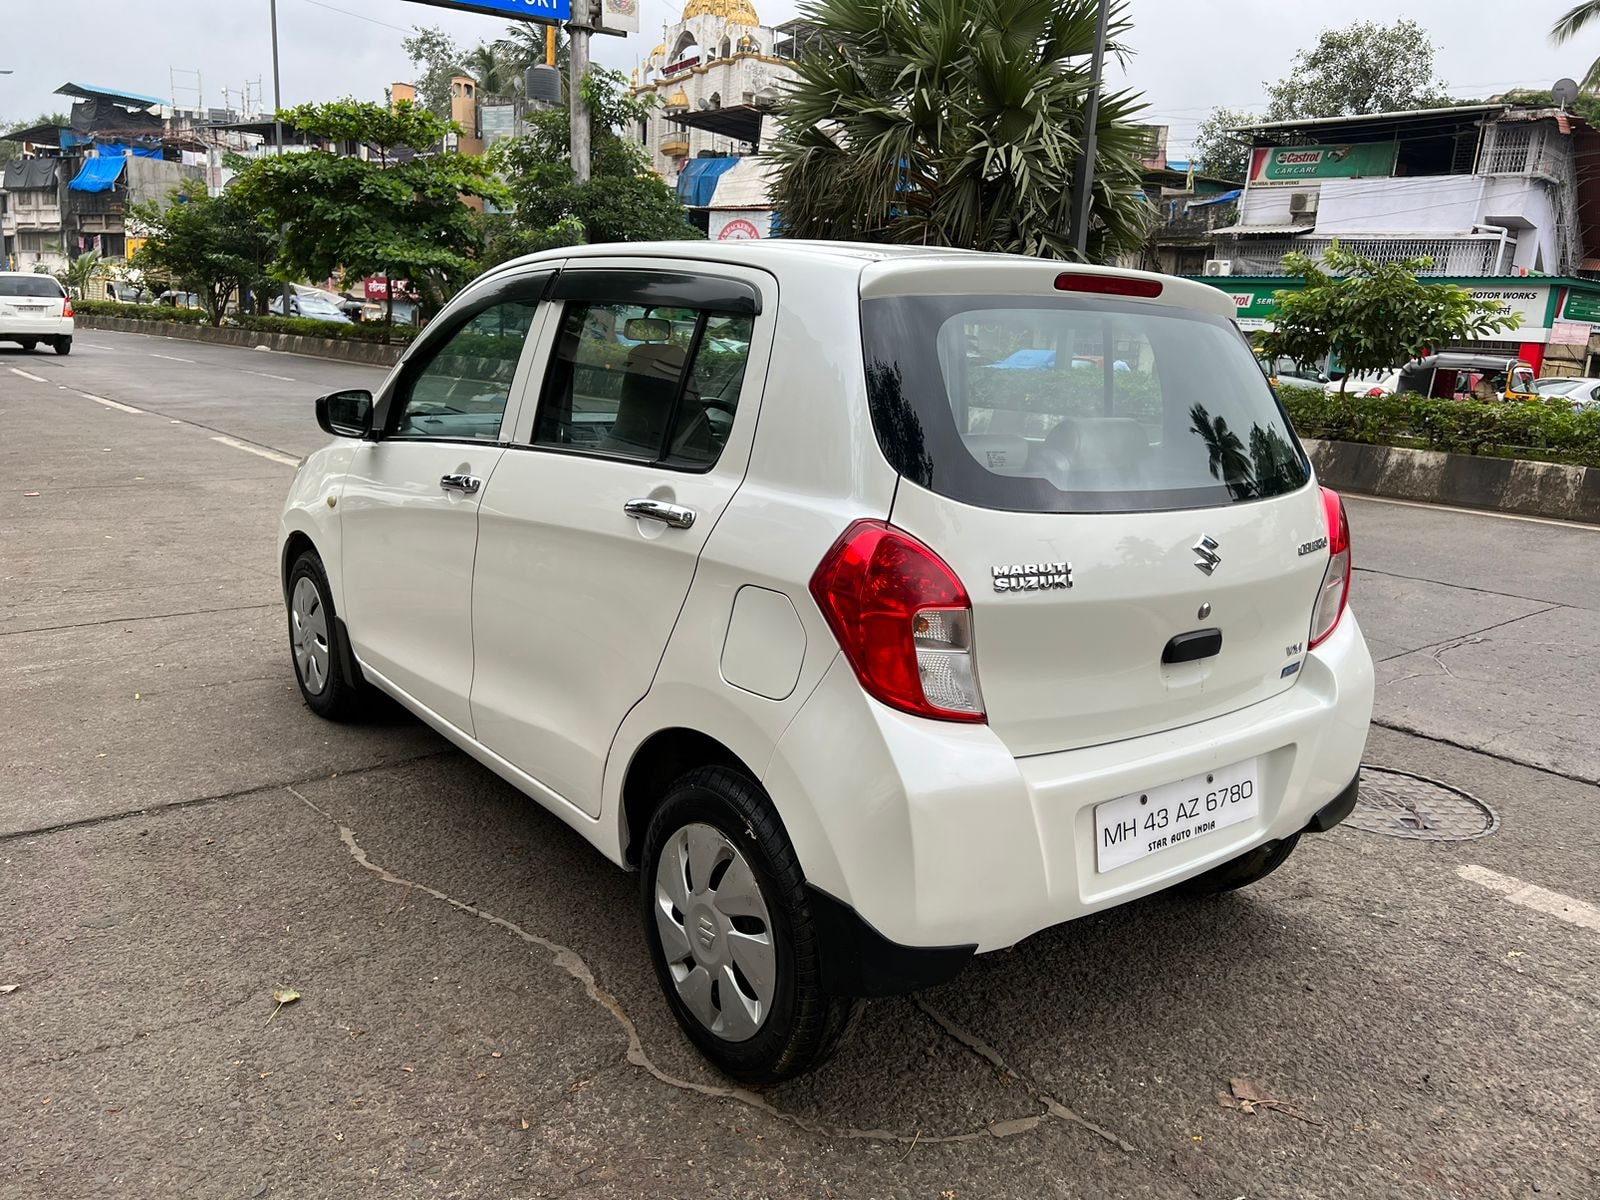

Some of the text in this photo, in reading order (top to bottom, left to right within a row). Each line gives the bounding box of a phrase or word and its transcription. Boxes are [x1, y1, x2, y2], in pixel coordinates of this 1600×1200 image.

[1287, 152, 1320, 163] Castrol
[1468, 291, 1537, 300] MOTOR WORKS
[991, 562, 1073, 577] MARUTI
[993, 574, 1074, 593] SUZUKI
[1104, 780, 1253, 847] MH 43 AZ 6780
[1148, 820, 1216, 852] STAR AUTO INDIA
